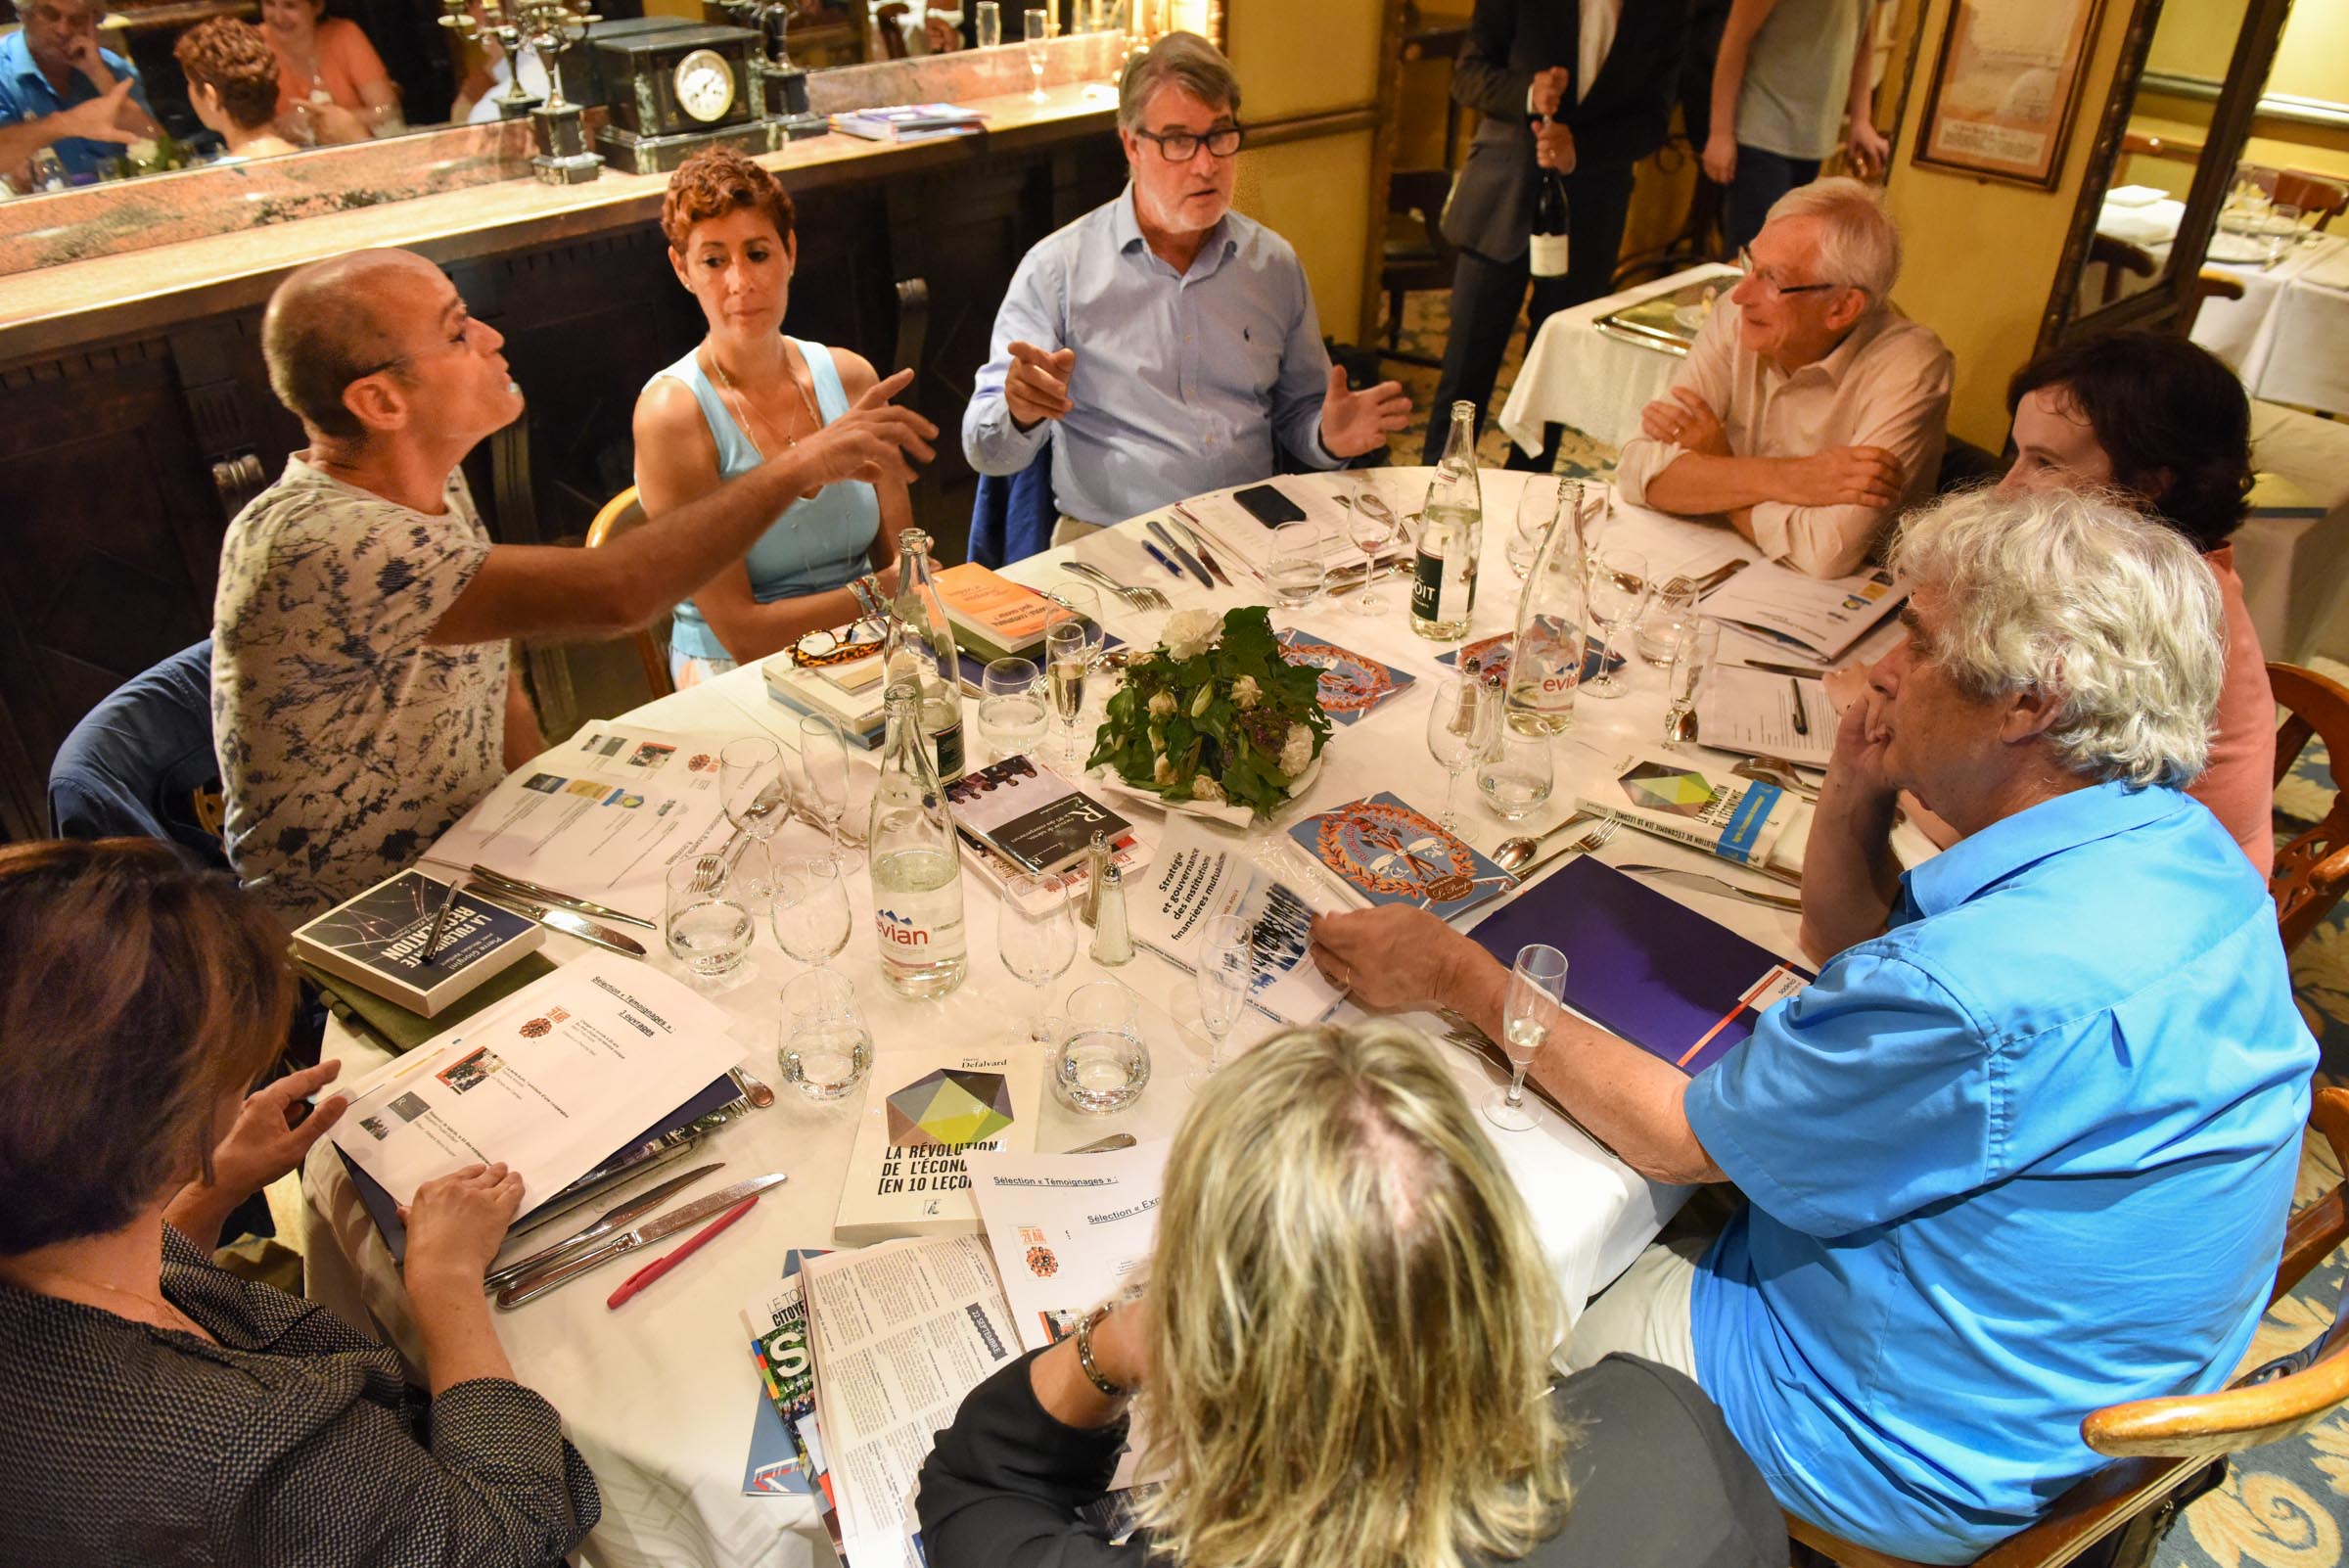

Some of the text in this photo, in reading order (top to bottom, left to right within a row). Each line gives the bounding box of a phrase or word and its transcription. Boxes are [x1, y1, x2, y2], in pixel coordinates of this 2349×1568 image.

[1414, 581, 1435, 600] OIT
[1158, 851, 1184, 892] Stratégie
[1160, 847, 1200, 913] et gouvernance
[1172, 853, 1213, 920] des institutions
[469, 913, 492, 927] LA
[1172, 893, 1210, 942] financières
[447, 936, 503, 971] Pierre Giorgini
[592, 974, 621, 996] Sélection
[623, 993, 668, 1027] Témoignages
[622, 1011, 656, 1037] ouvrages
[884, 1145, 901, 1160] LA
[881, 1162, 899, 1176] DE
[876, 1174, 971, 1194] [EN 10 LEÇO
[1045, 1177, 1103, 1186] Témoignages
[1086, 1205, 1131, 1224] Sélection
[766, 1297, 782, 1314] LE
[772, 1299, 805, 1326] CITOYE
[971, 1310, 1000, 1354] 22 SEPTEMBRE
[783, 1384, 794, 1393] Le
